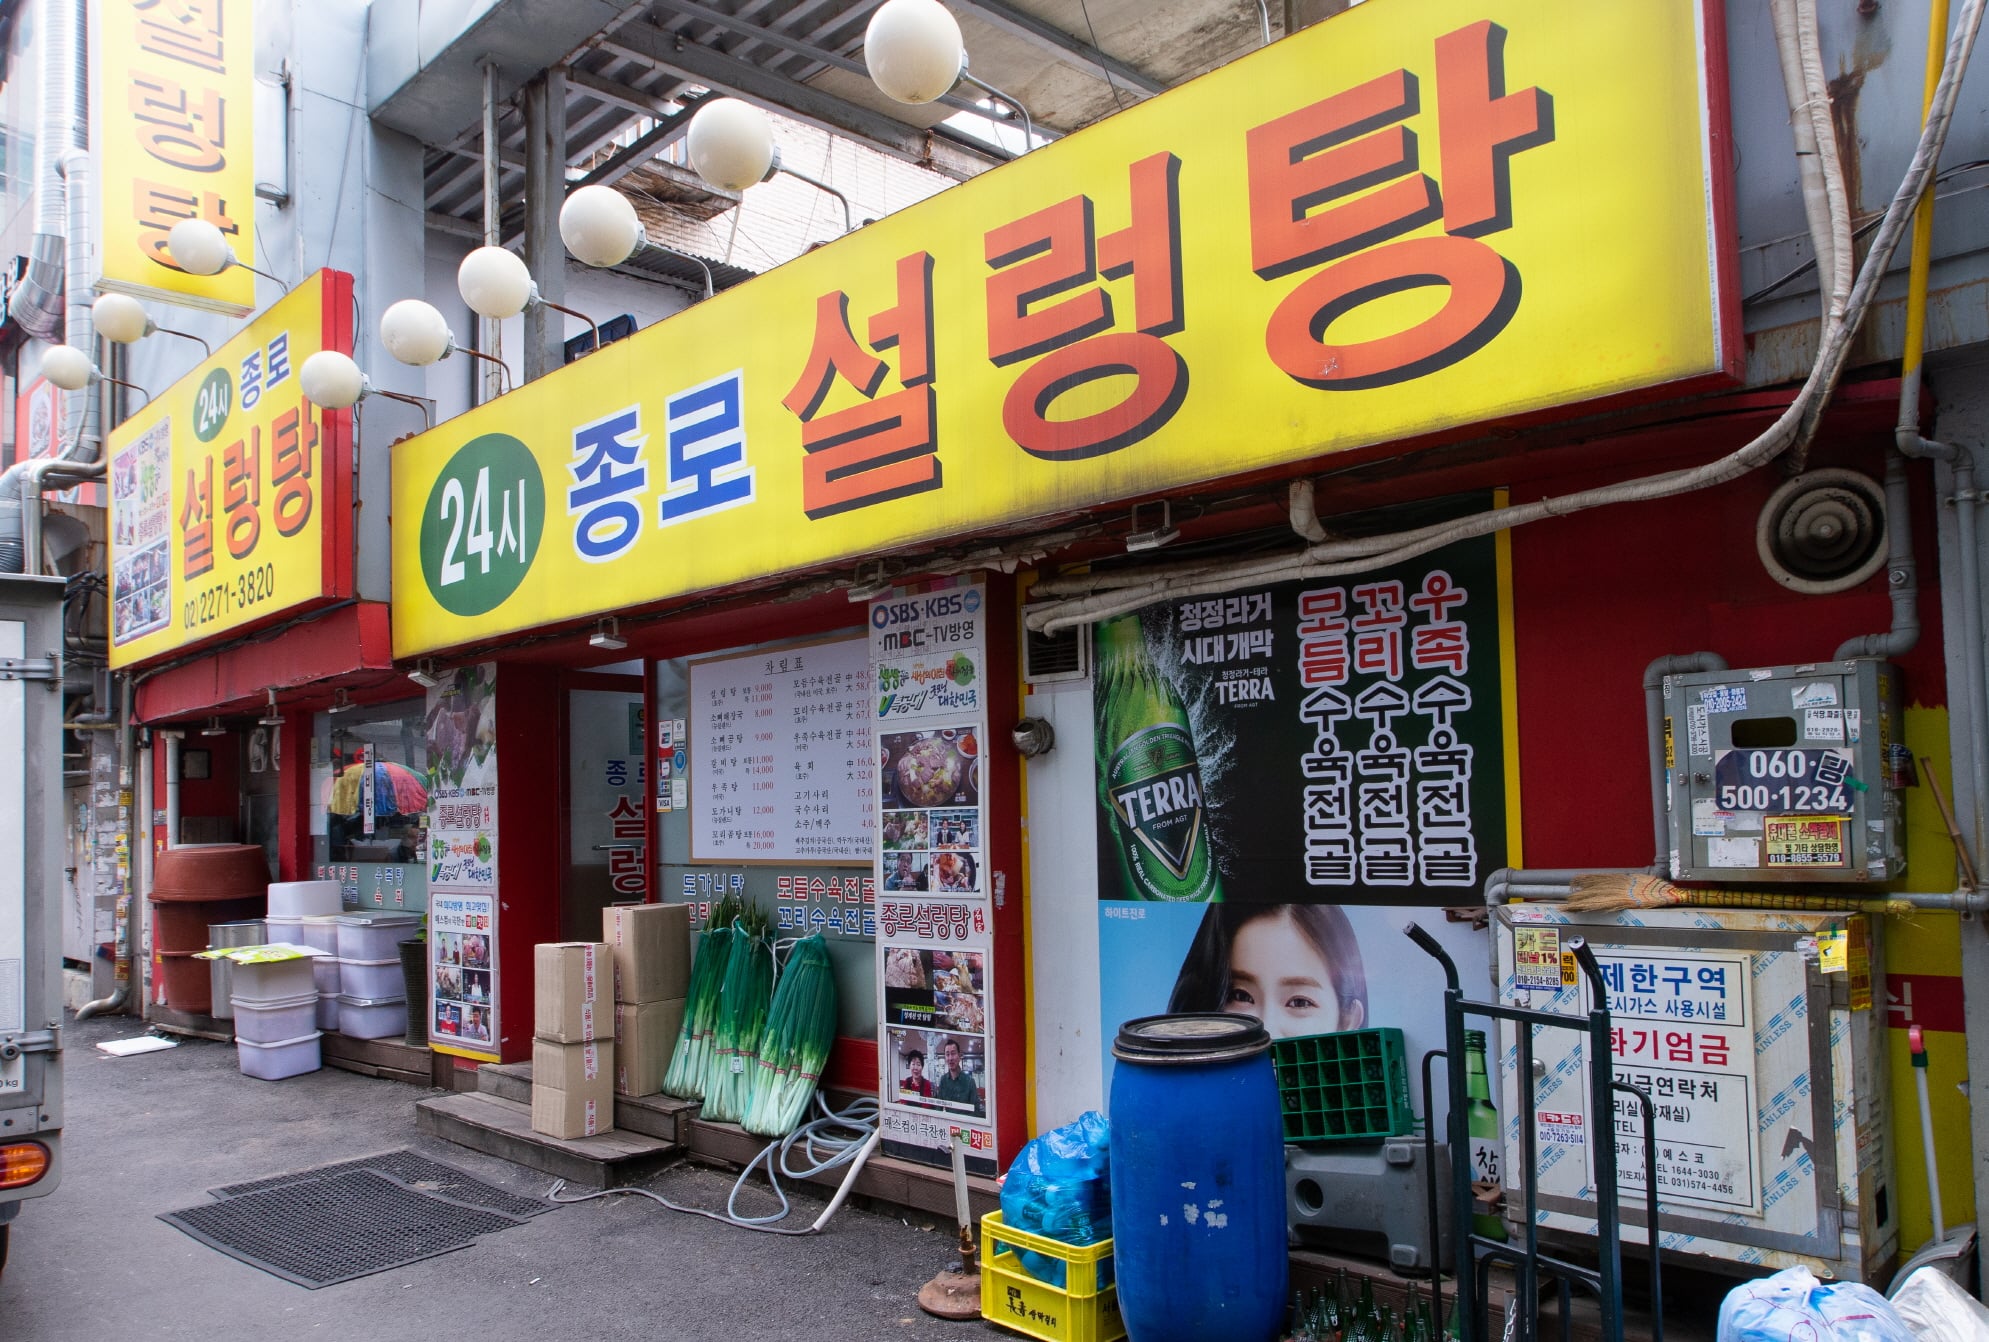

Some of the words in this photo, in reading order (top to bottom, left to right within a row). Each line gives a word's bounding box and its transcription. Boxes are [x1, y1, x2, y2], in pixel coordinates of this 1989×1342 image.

[781, 20, 1556, 521] 설렁탕
[240, 331, 292, 412] 종로
[200, 382, 228, 433] 24시
[179, 395, 318, 582] 설렁탕
[440, 466, 527, 586] 24시
[567, 371, 755, 563] 종로
[184, 563, 274, 630] 02)2271-3820
[1179, 592, 1273, 632] 청정라거
[1180, 635, 1225, 665] 시대
[1226, 631, 1275, 661] 개막
[938, 689, 977, 708] 대한민국
[1215, 677, 1275, 705] TERRA
[1299, 588, 1354, 884] 모듬수육전골
[1354, 582, 1413, 884] 꼬리수육전골
[1411, 572, 1475, 884] 우족수육전골
[752, 782, 773, 790] 11,000
[794, 789, 829, 800] 고기사리
[659, 798, 670, 808] VISA
[753, 806, 774, 814] 12,000
[794, 804, 829, 815] 국수사리
[1118, 772, 1202, 829] TERRA
[753, 830, 774, 838] 16,000
[1152, 819, 1173, 831] FROM
[1174, 814, 1188, 824] AGT
[1769, 823, 1797, 841] 휴대폰
[753, 841, 774, 850] 20,000
[1795, 843, 1808, 853] 기타
[1134, 860, 1145, 881] REAL
[1770, 854, 1840, 863] 010-8655-5579
[683, 873, 745, 898] 도가니탕
[880, 903, 969, 940] 종로설렁탕
[1541, 952, 1557, 964] 1%
[1603, 962, 1726, 999] 제한구역
[1665, 999, 1726, 1020] 사용시설
[884, 1116, 918, 1136] 매스컴이
[919, 1122, 947, 1141] 극찬한
[1476, 1145, 1499, 1175] 참
[1671, 1177, 1734, 1194] 031)574-4456
[1672, 1166, 1719, 1180] 1644-3030
